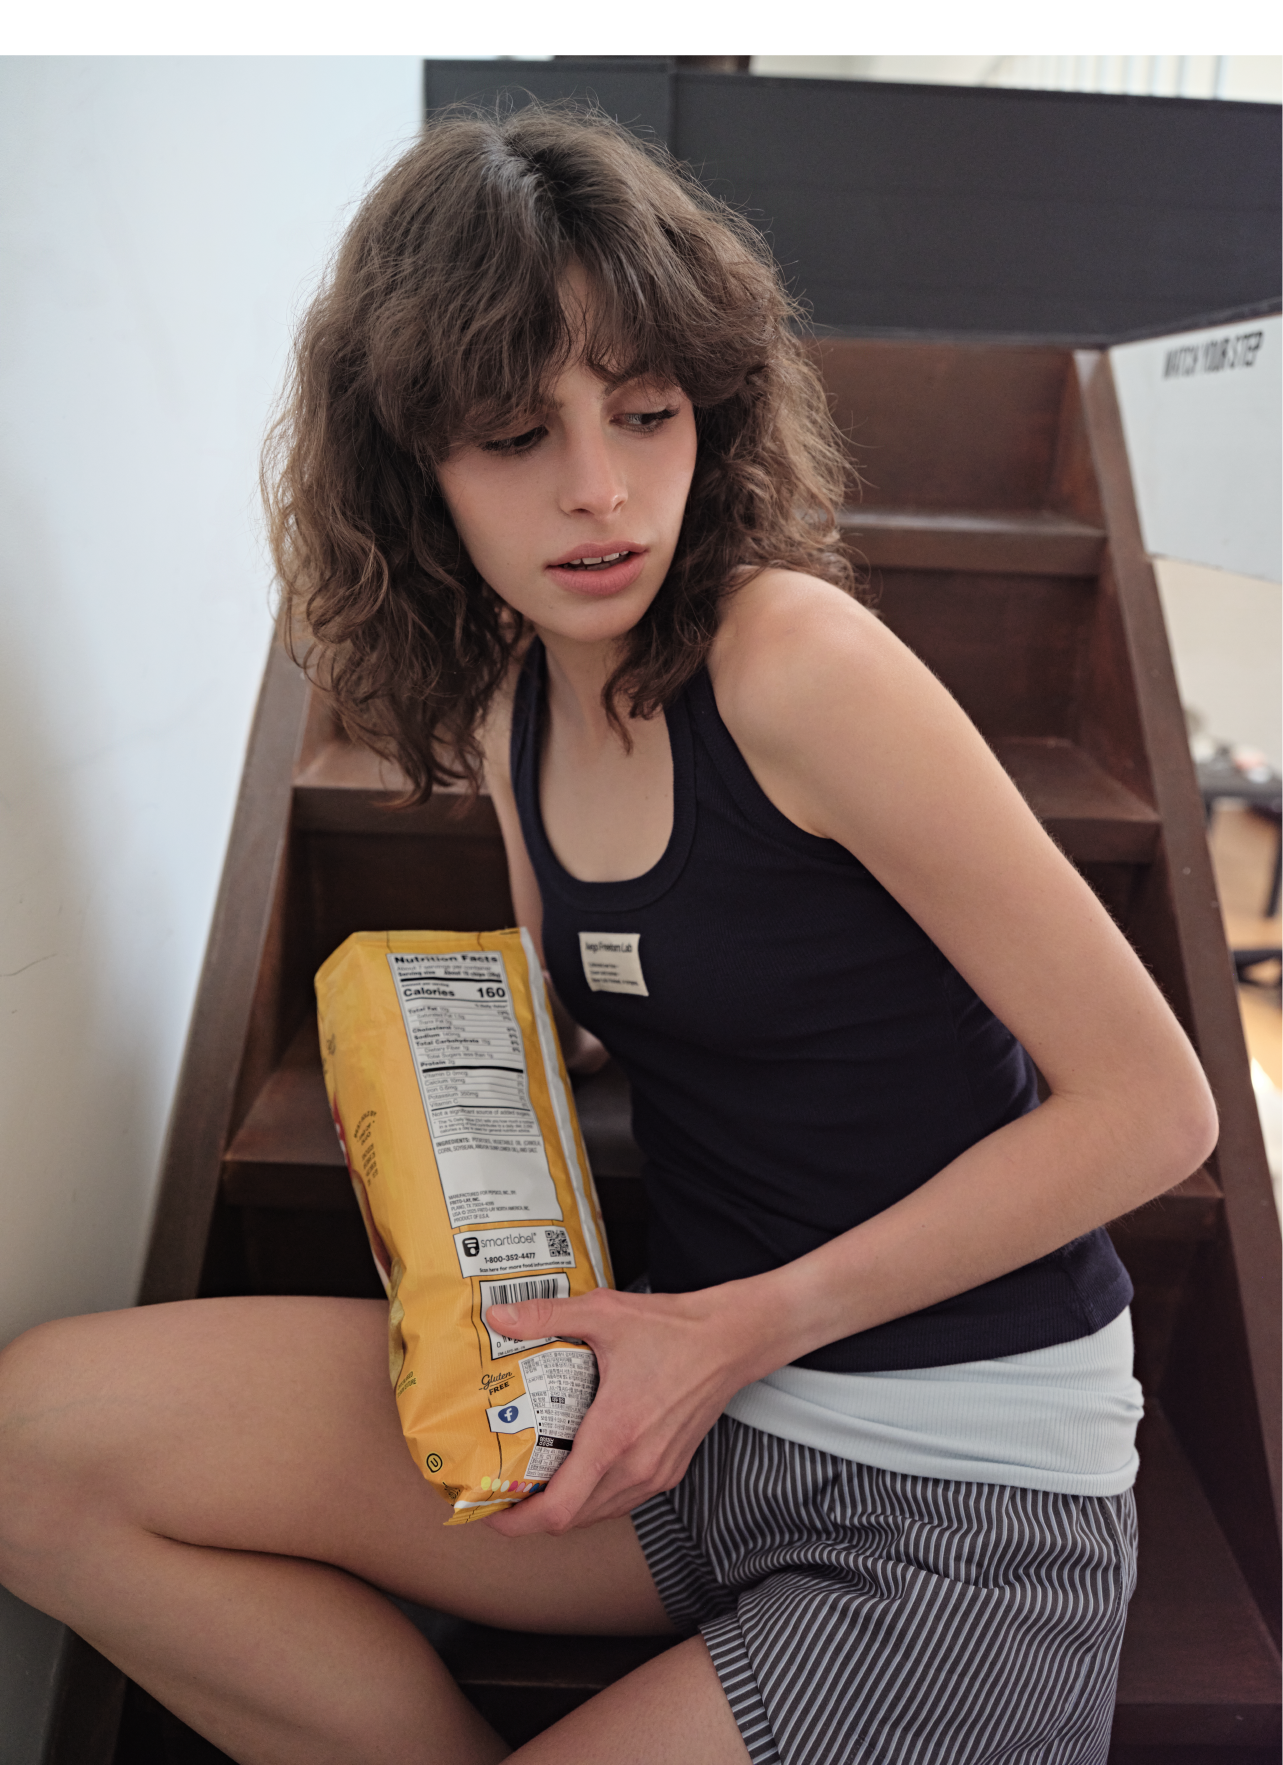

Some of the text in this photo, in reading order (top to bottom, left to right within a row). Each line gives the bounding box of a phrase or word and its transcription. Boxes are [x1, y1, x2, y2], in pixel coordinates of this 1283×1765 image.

[404, 987, 505, 997] Calories 160
[484, 1252, 535, 1263] 1-800-352-4477
[481, 1372, 512, 1390] Gluten
[489, 1381, 509, 1395] FREE
